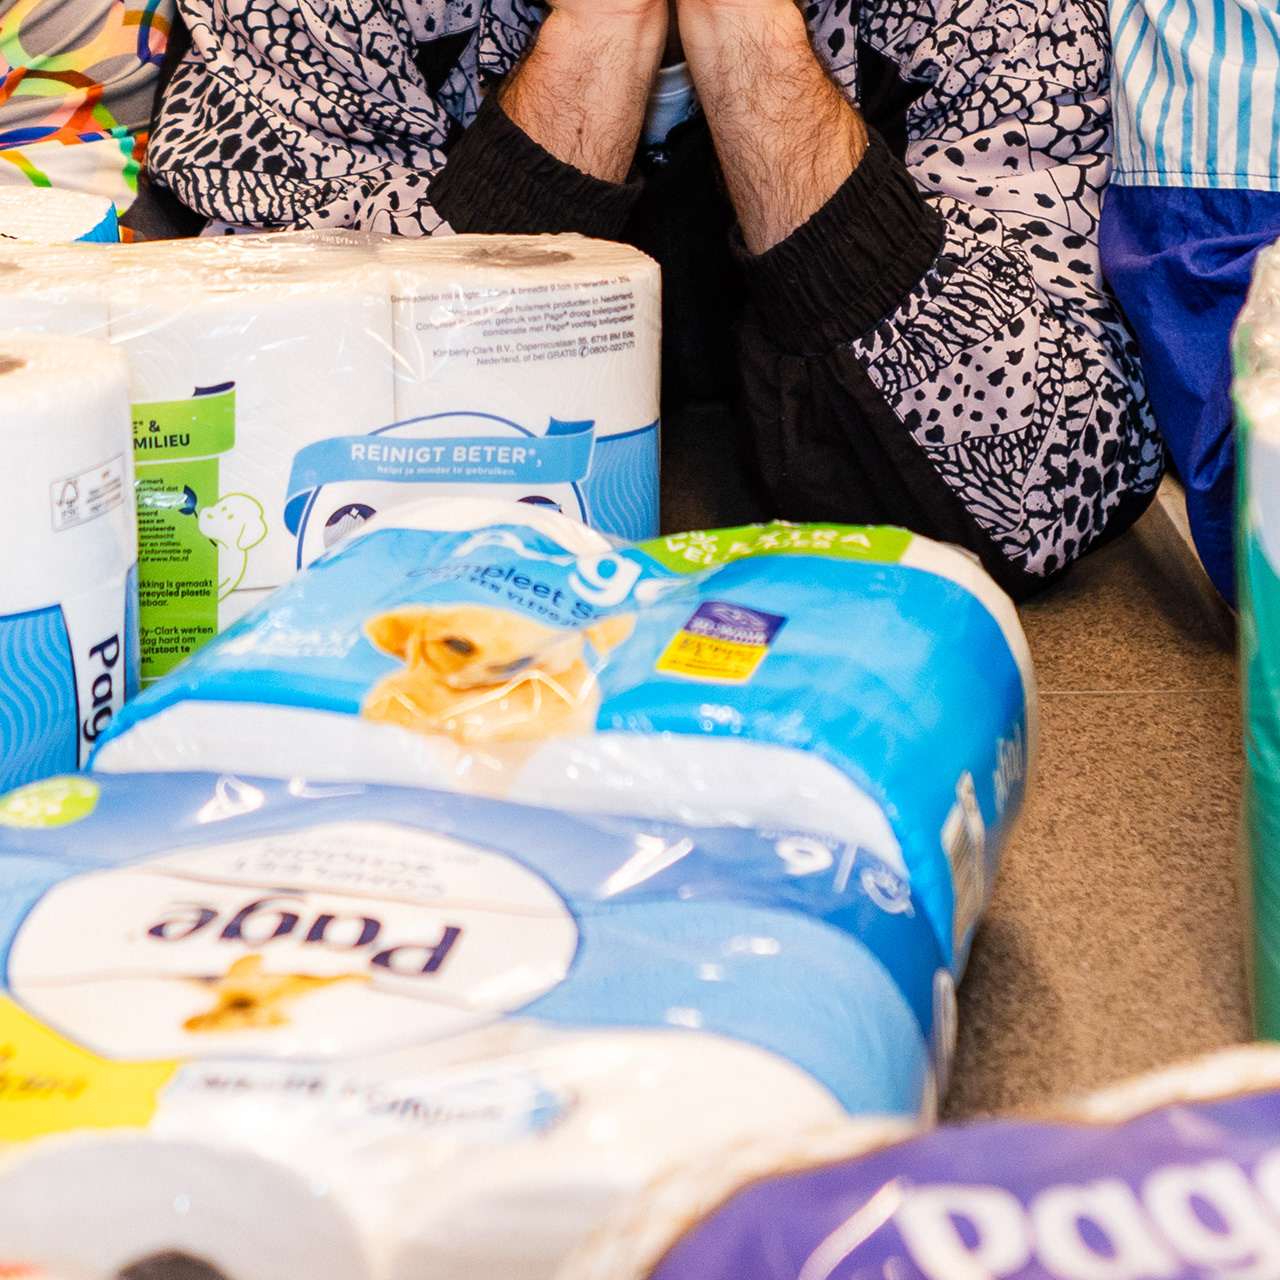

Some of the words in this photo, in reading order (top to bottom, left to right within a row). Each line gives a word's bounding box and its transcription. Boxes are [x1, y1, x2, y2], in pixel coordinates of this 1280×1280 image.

[546, 349, 577, 360] GRATIS
[149, 420, 160, 433] &
[133, 434, 190, 450] MILIEU
[350, 443, 446, 464] REINIGT
[377, 464, 404, 476] helpt
[405, 465, 415, 477] je
[452, 465, 463, 474] te
[175, 580, 213, 590] gemaakt
[181, 589, 211, 599] plastic
[180, 626, 214, 635] werken
[158, 636, 180, 645] hard
[180, 645, 191, 654] te
[145, 890, 464, 978] Page
